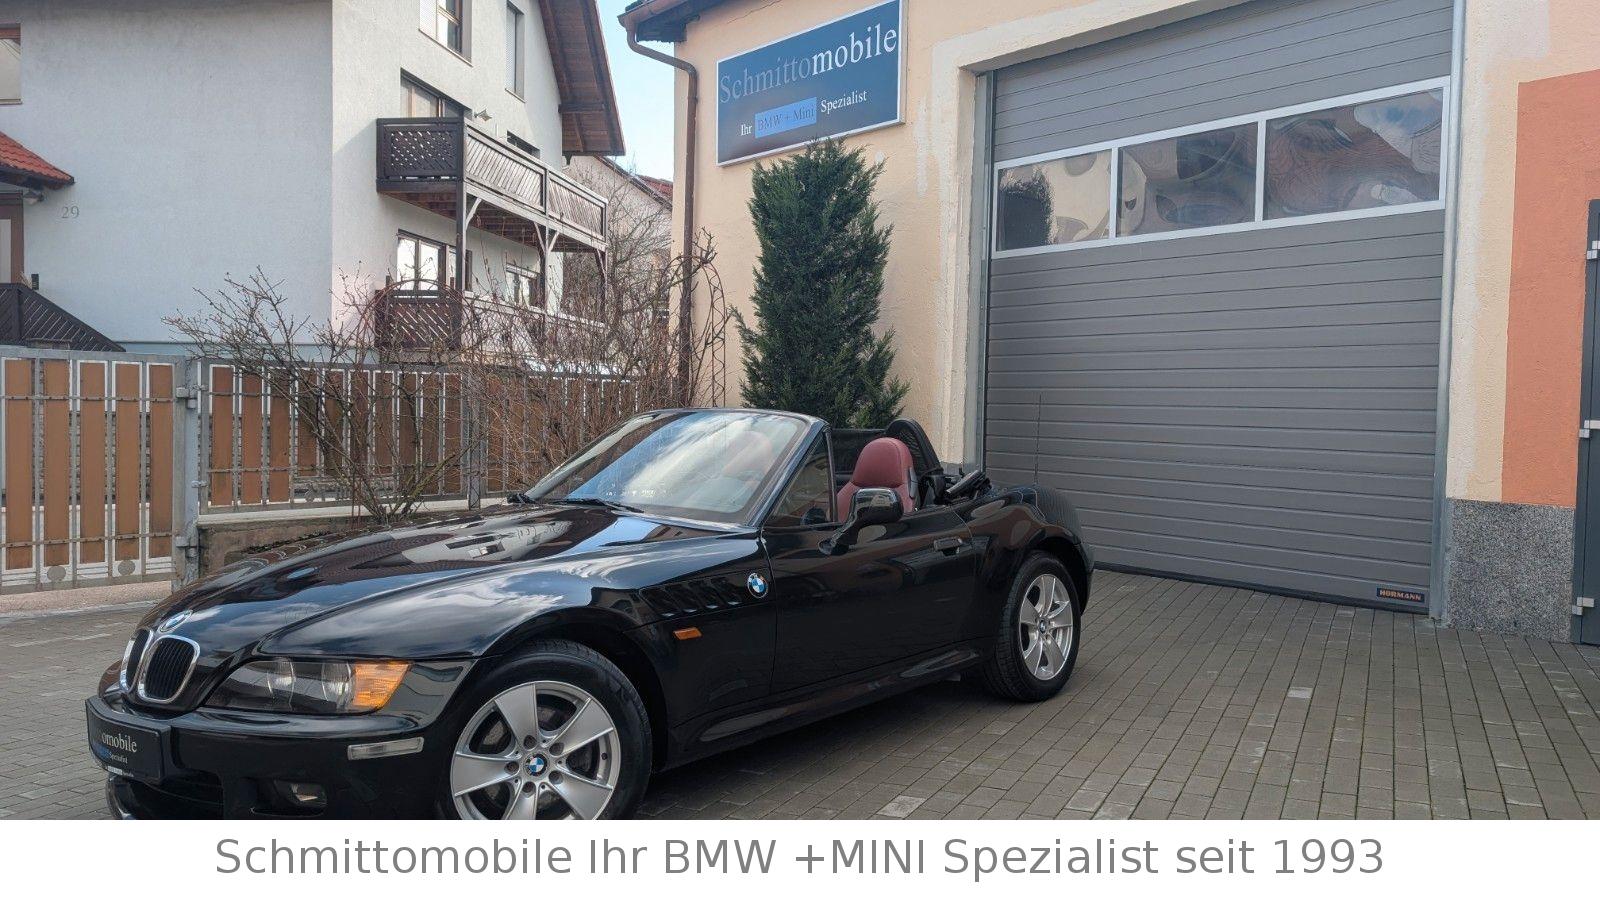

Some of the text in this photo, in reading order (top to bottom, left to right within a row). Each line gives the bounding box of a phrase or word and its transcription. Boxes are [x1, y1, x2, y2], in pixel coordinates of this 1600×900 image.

[720, 23, 897, 104] Schmittomobile
[740, 123, 753, 137] Ihr
[757, 114, 783, 131] BMW
[793, 107, 815, 121] Mini
[820, 90, 868, 115] Spezialist
[62, 205, 80, 219] 29
